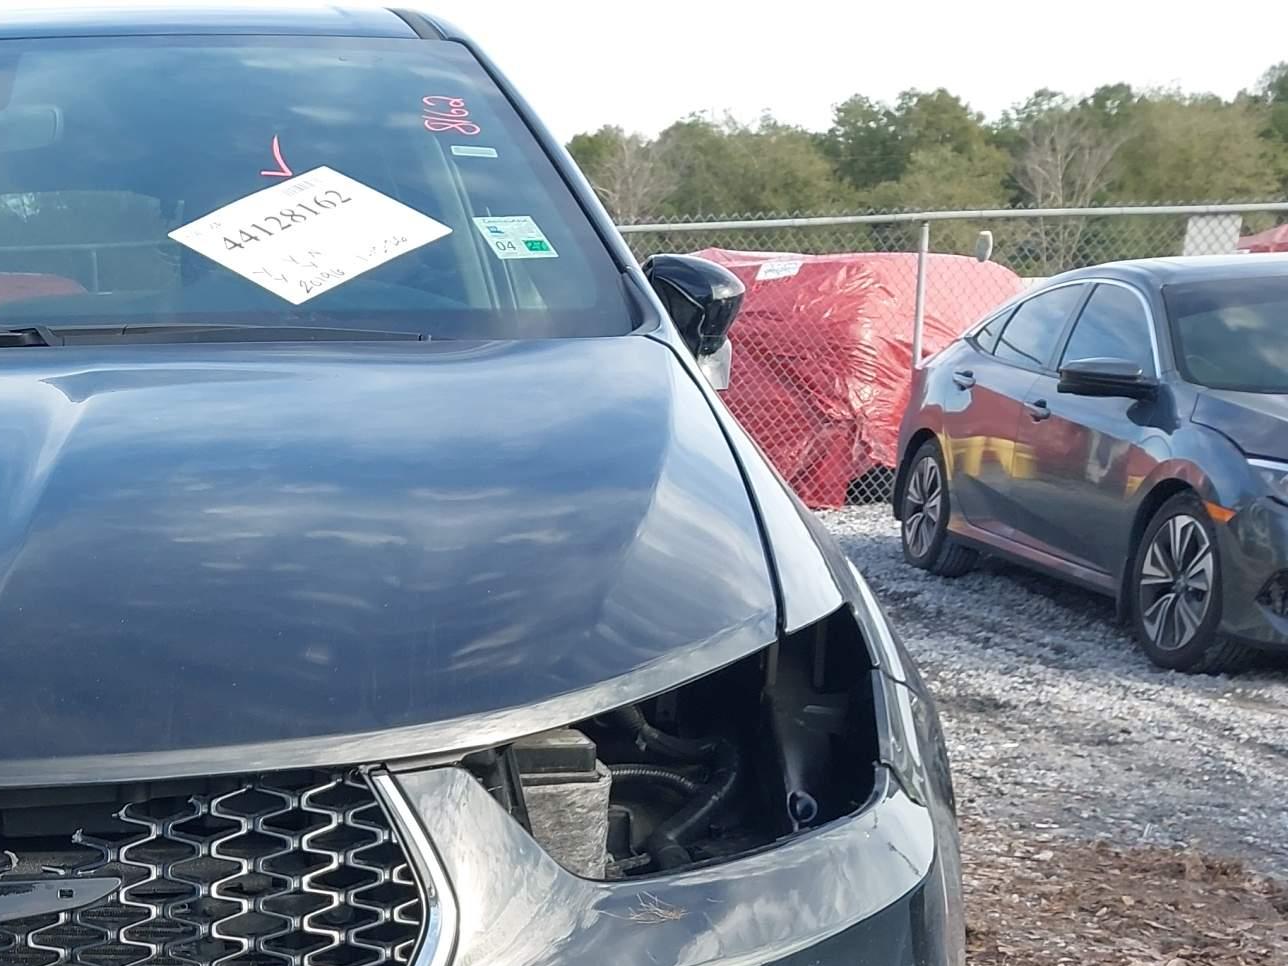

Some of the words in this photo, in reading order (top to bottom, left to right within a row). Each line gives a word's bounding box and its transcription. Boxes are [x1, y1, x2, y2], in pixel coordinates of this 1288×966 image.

[422, 95, 481, 135] 8162
[223, 190, 352, 250] 44128162
[495, 240, 517, 251] 04
